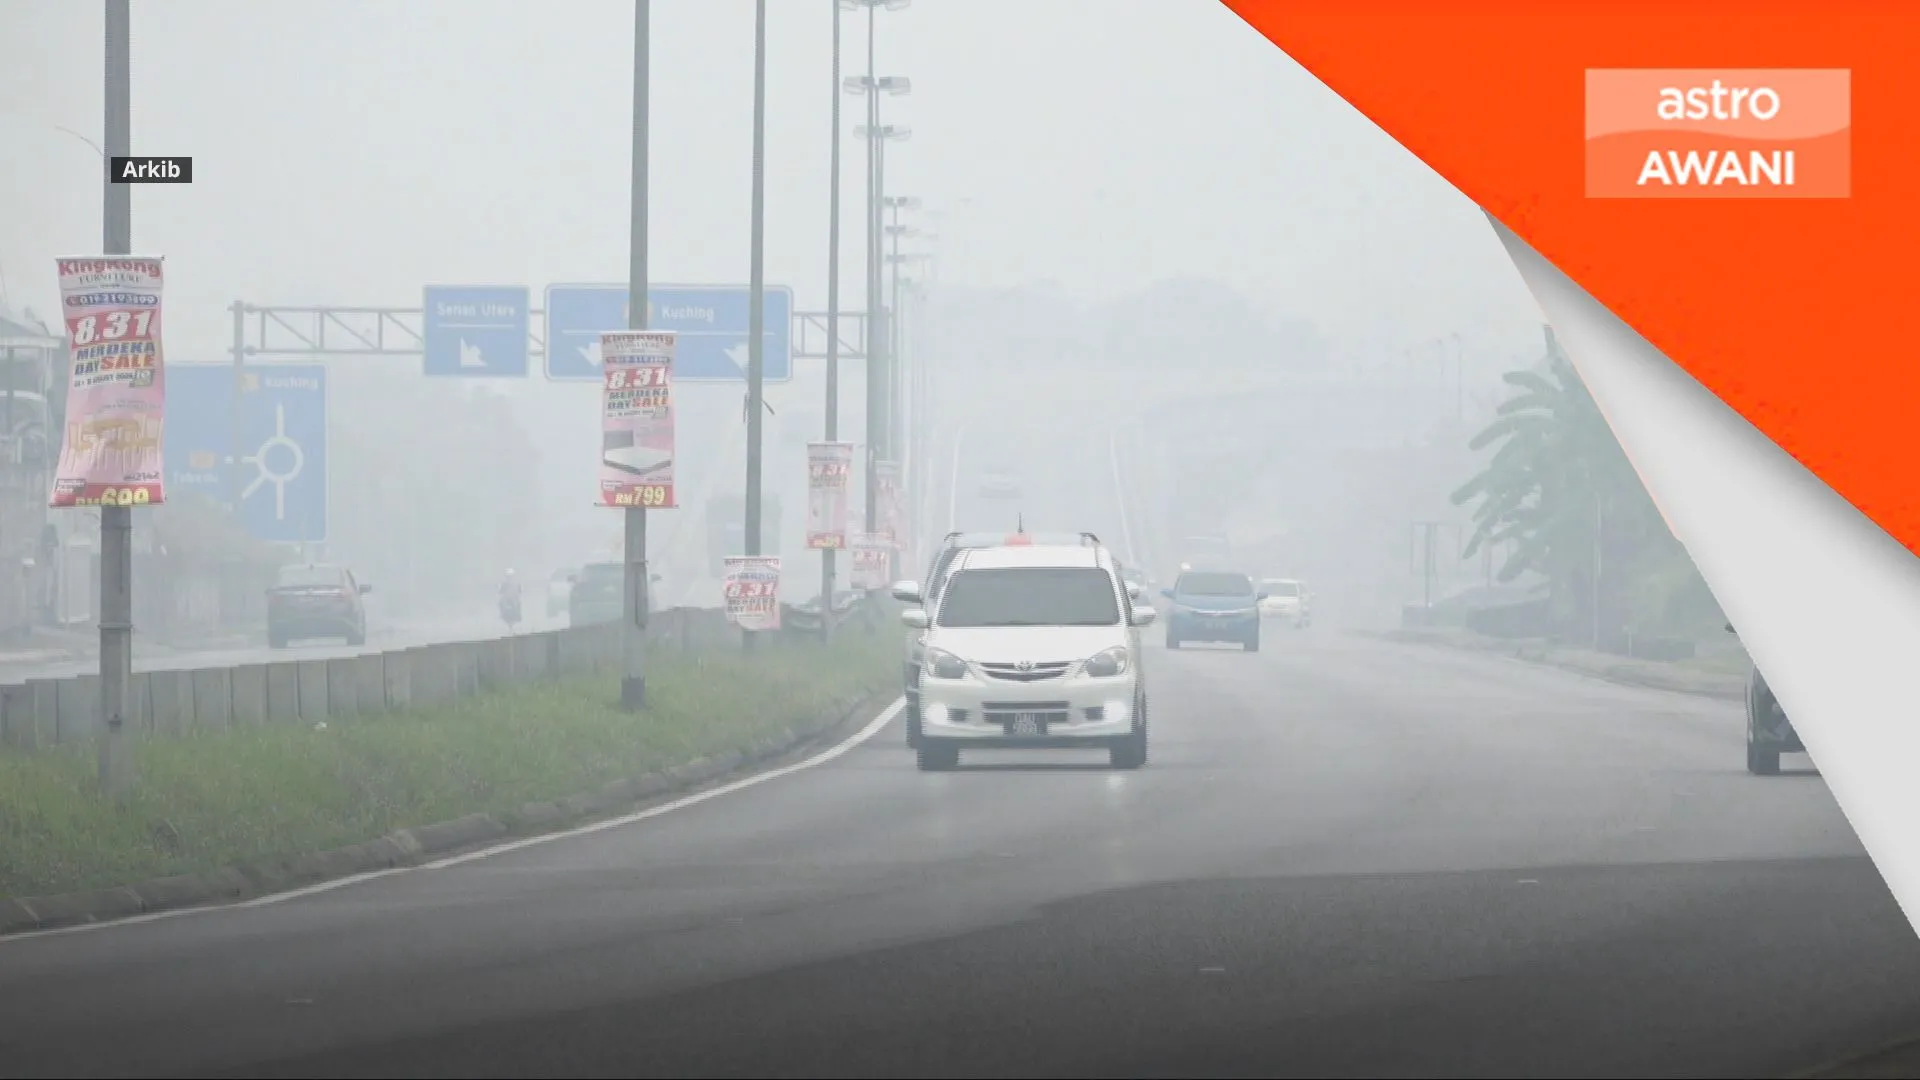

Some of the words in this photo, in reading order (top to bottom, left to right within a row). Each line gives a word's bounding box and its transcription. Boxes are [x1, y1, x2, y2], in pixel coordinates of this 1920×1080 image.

[662, 305, 714, 322] Kuching
[75, 311, 151, 344] 8.31
[77, 342, 155, 360] MERDEKA
[101, 354, 155, 370] SALE
[608, 367, 666, 389] 8.31
